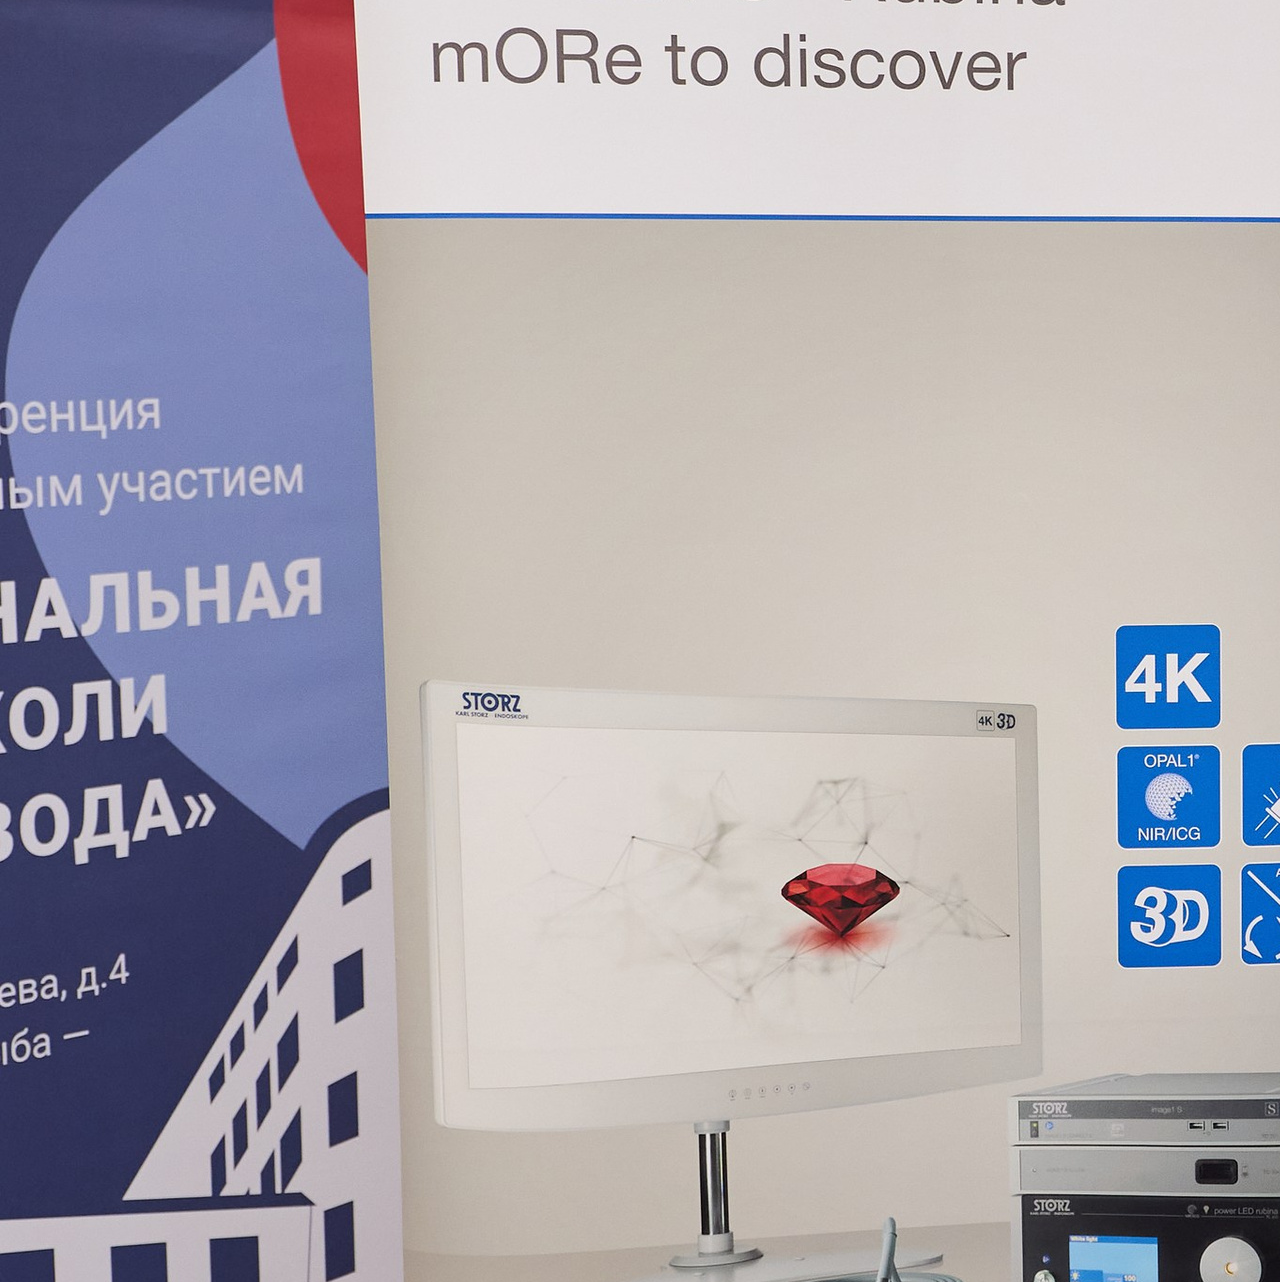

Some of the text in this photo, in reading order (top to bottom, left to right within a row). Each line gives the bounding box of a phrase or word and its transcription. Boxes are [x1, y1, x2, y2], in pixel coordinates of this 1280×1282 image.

[432, 26, 1028, 91] mORe to discover
[0, 462, 304, 517] ым участием
[1124, 652, 1213, 704] 4K
[0, 673, 168, 755] ОЛИ
[462, 692, 521, 712] STORZ
[978, 712, 1016, 730] 4K 3D
[1137, 825, 1201, 842] NIR/ICG
[1129, 885, 1210, 948] 3D
[76, 952, 131, 1000] д.4
[1032, 1101, 1068, 1114] STORZ
[1033, 1198, 1071, 1212] STORZ
[1213, 1206, 1279, 1216] power LED rubina
